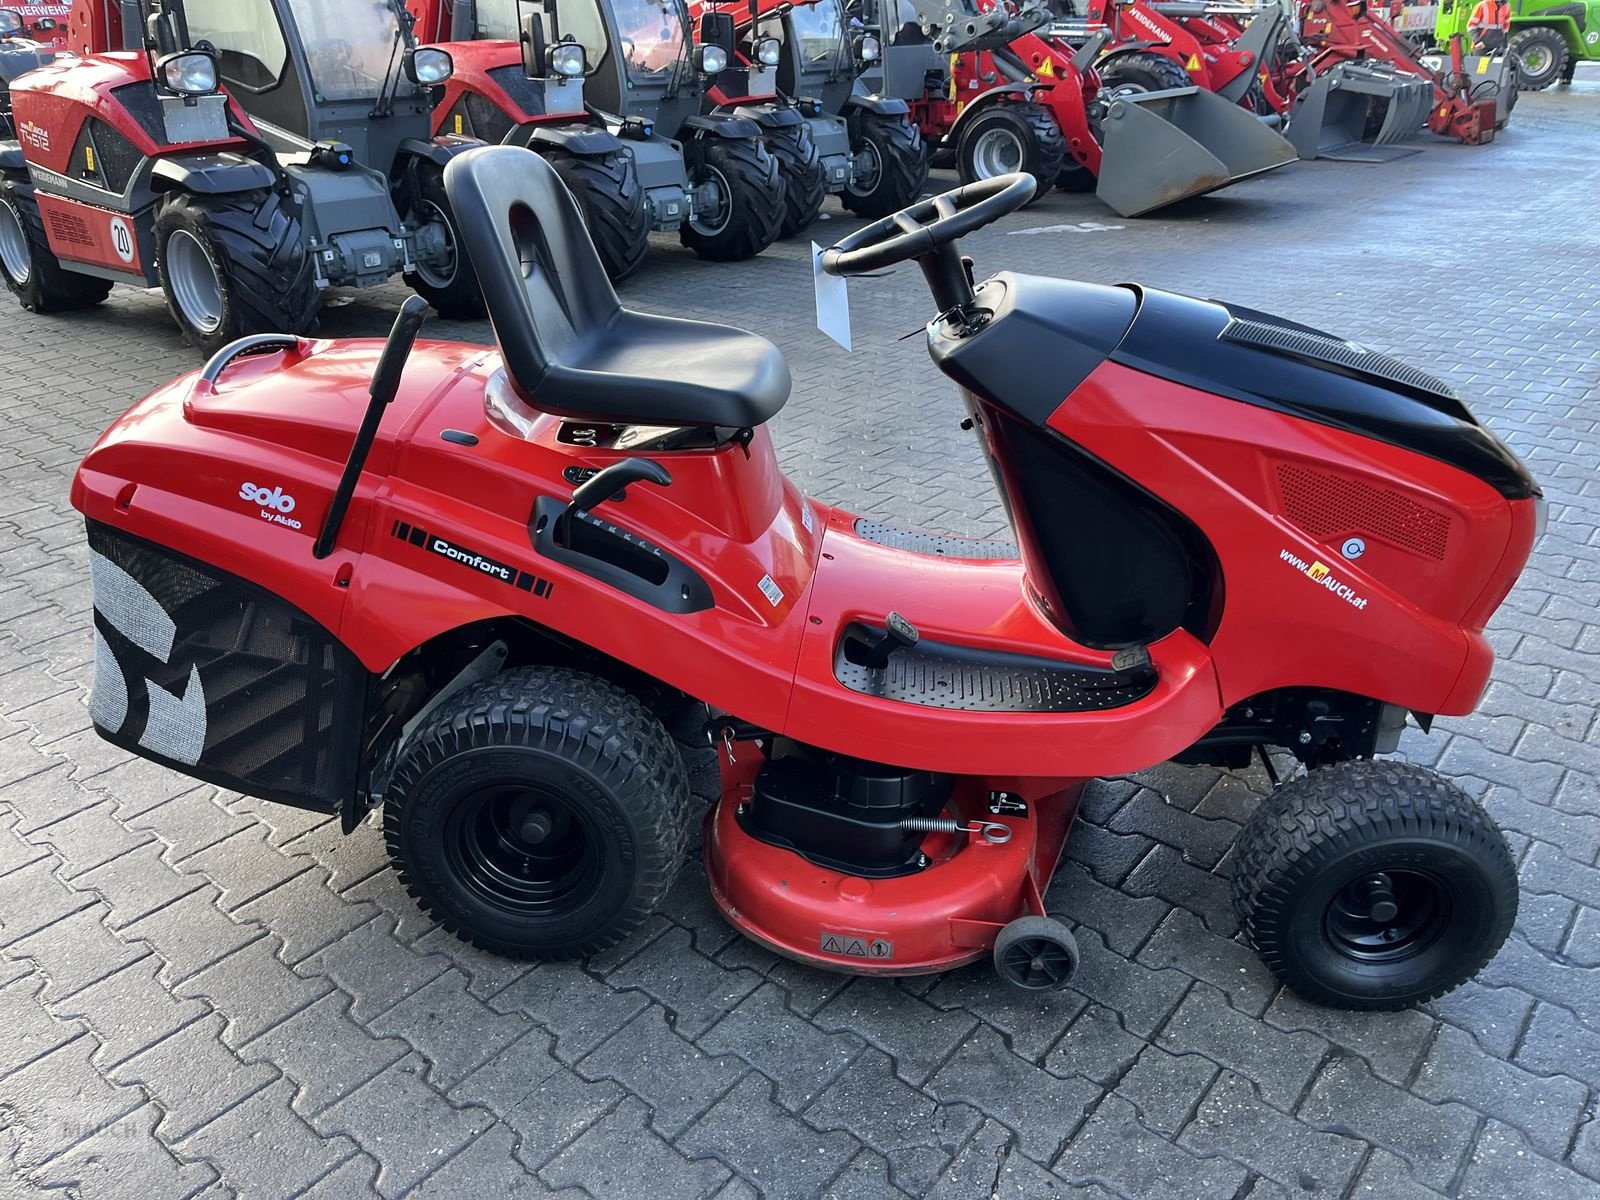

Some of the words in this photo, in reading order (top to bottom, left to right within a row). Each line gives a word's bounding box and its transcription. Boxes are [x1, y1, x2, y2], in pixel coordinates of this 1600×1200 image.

[19, 128, 50, 152] T4512
[31, 167, 68, 188] WEIDEMANN
[113, 224, 130, 255] 20
[238, 482, 296, 513] solo
[260, 509, 275, 522] by
[433, 539, 510, 579] Comfort
[1279, 548, 1368, 610] www.MAUCH.at
